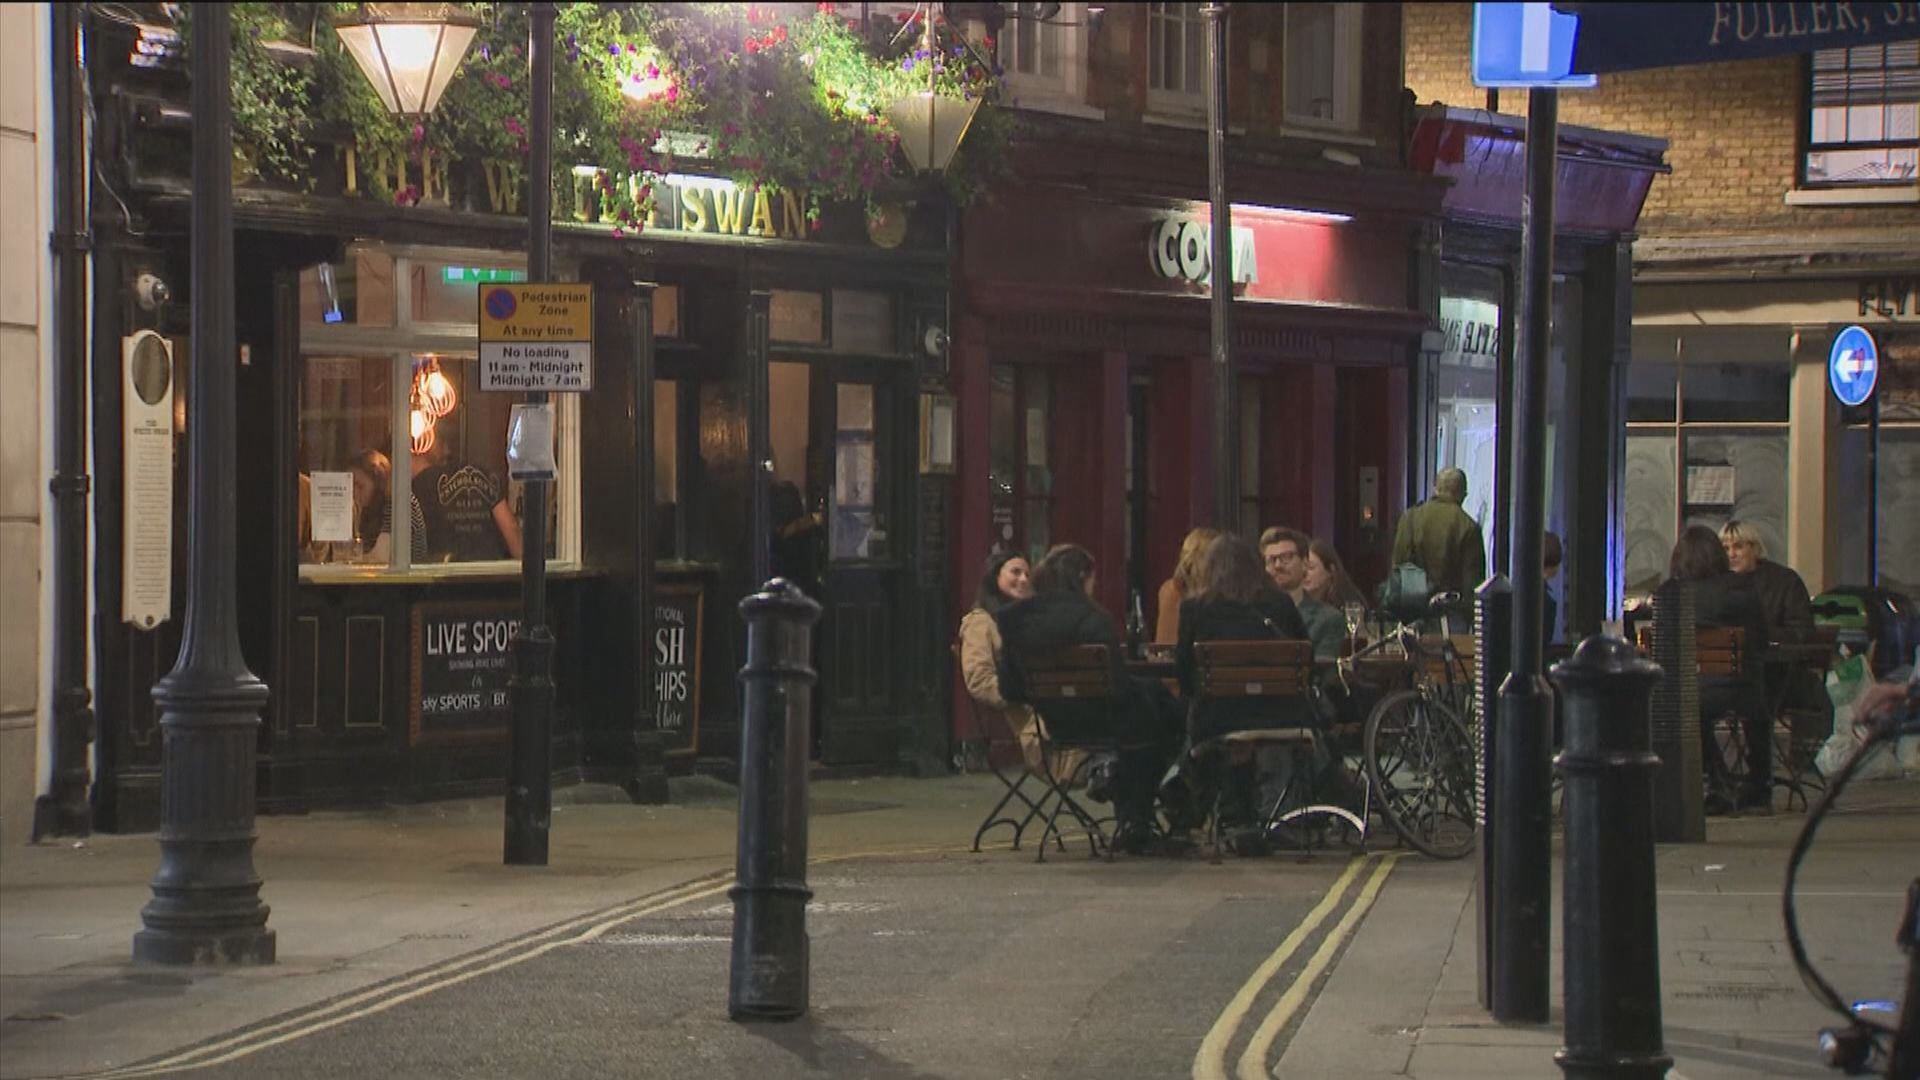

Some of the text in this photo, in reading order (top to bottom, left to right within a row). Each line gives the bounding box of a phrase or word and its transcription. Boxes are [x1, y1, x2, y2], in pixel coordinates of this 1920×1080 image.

[680, 183, 808, 239] SWAN
[1150, 219, 1259, 284] COA
[521, 291, 587, 303] Pedestrian
[539, 305, 569, 316] Zone
[503, 325, 575, 338] At any time
[503, 346, 570, 360] No loading
[529, 361, 584, 374] Midnight
[490, 374, 545, 387] Midnight
[427, 620, 521, 655] LIVE SPOR
[422, 695, 438, 712] sky
[439, 693, 481, 711] SPORTS
